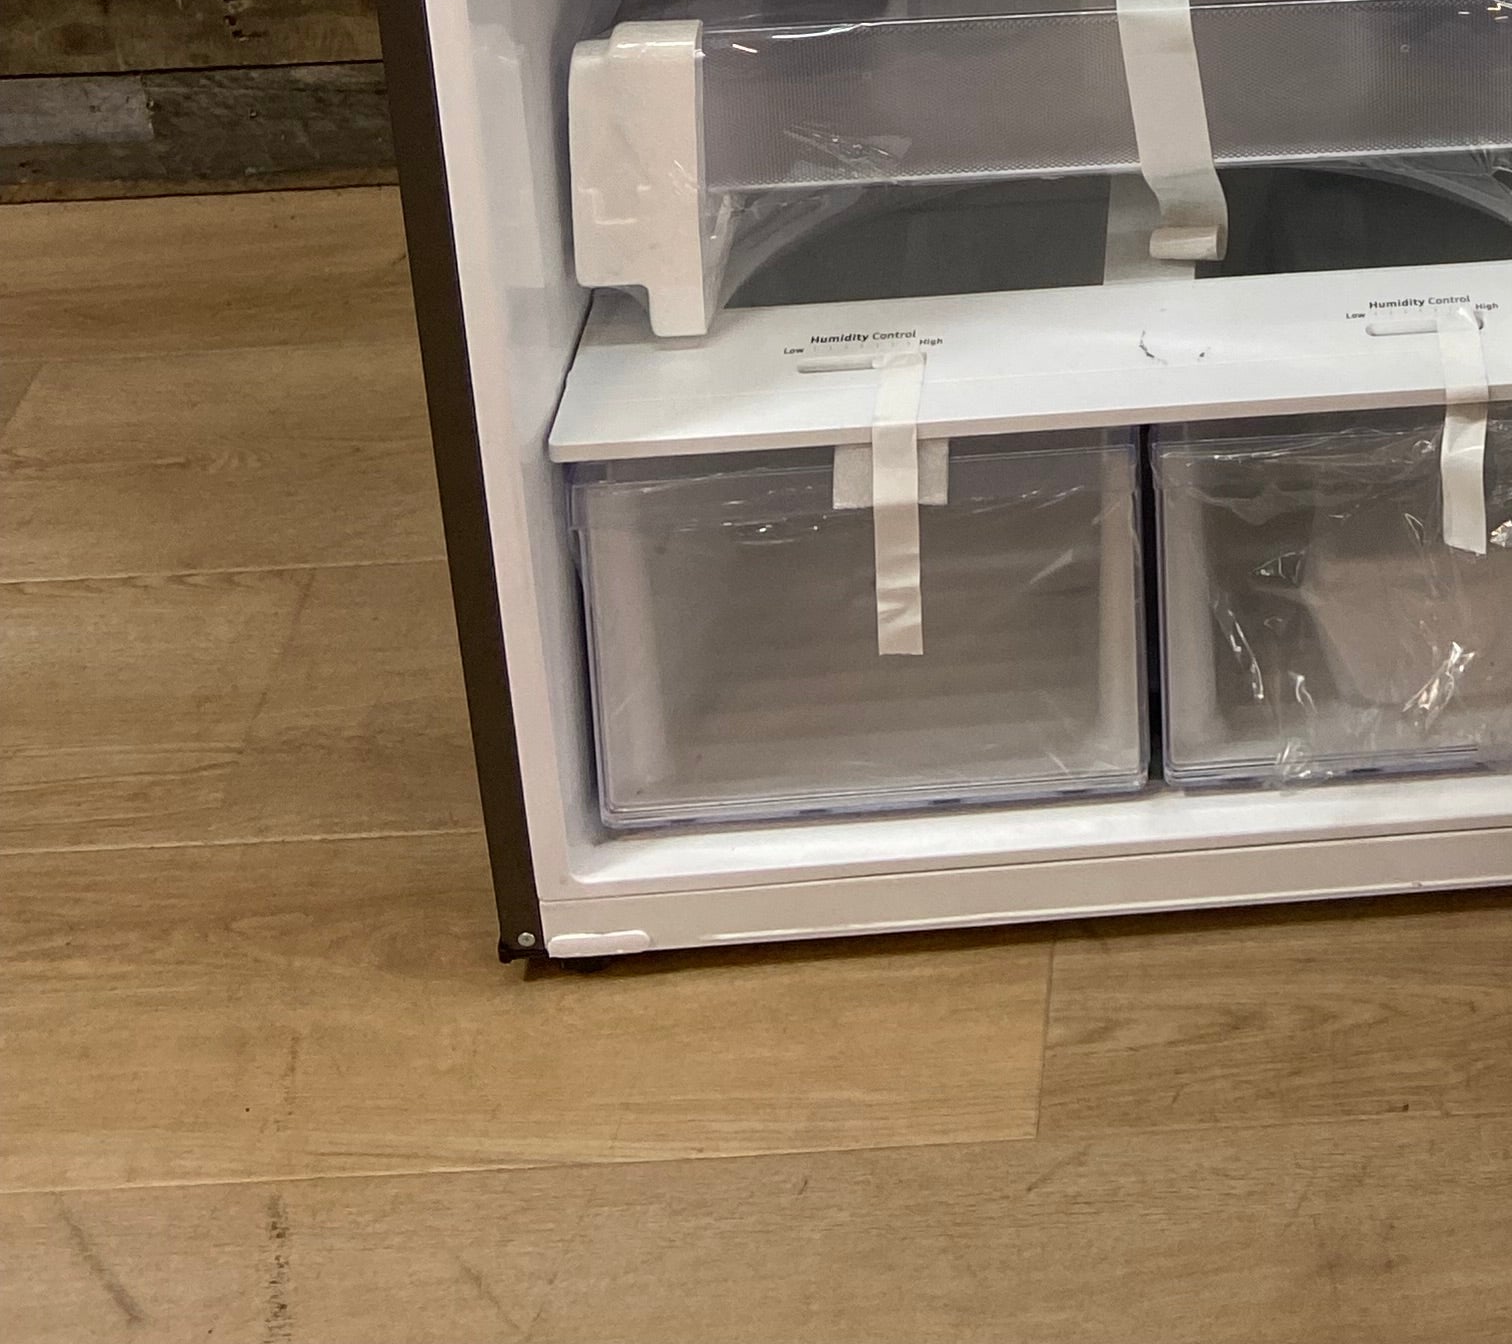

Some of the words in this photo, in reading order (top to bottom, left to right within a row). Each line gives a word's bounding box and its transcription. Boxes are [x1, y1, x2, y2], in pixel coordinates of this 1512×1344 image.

[1369, 297, 1425, 310] Humidity
[1428, 295, 1471, 305] Control
[1475, 302, 1499, 312] High
[810, 333, 870, 345] Humidity
[872, 330, 917, 341] Control
[783, 347, 805, 355] Low
[919, 337, 944, 348] High
